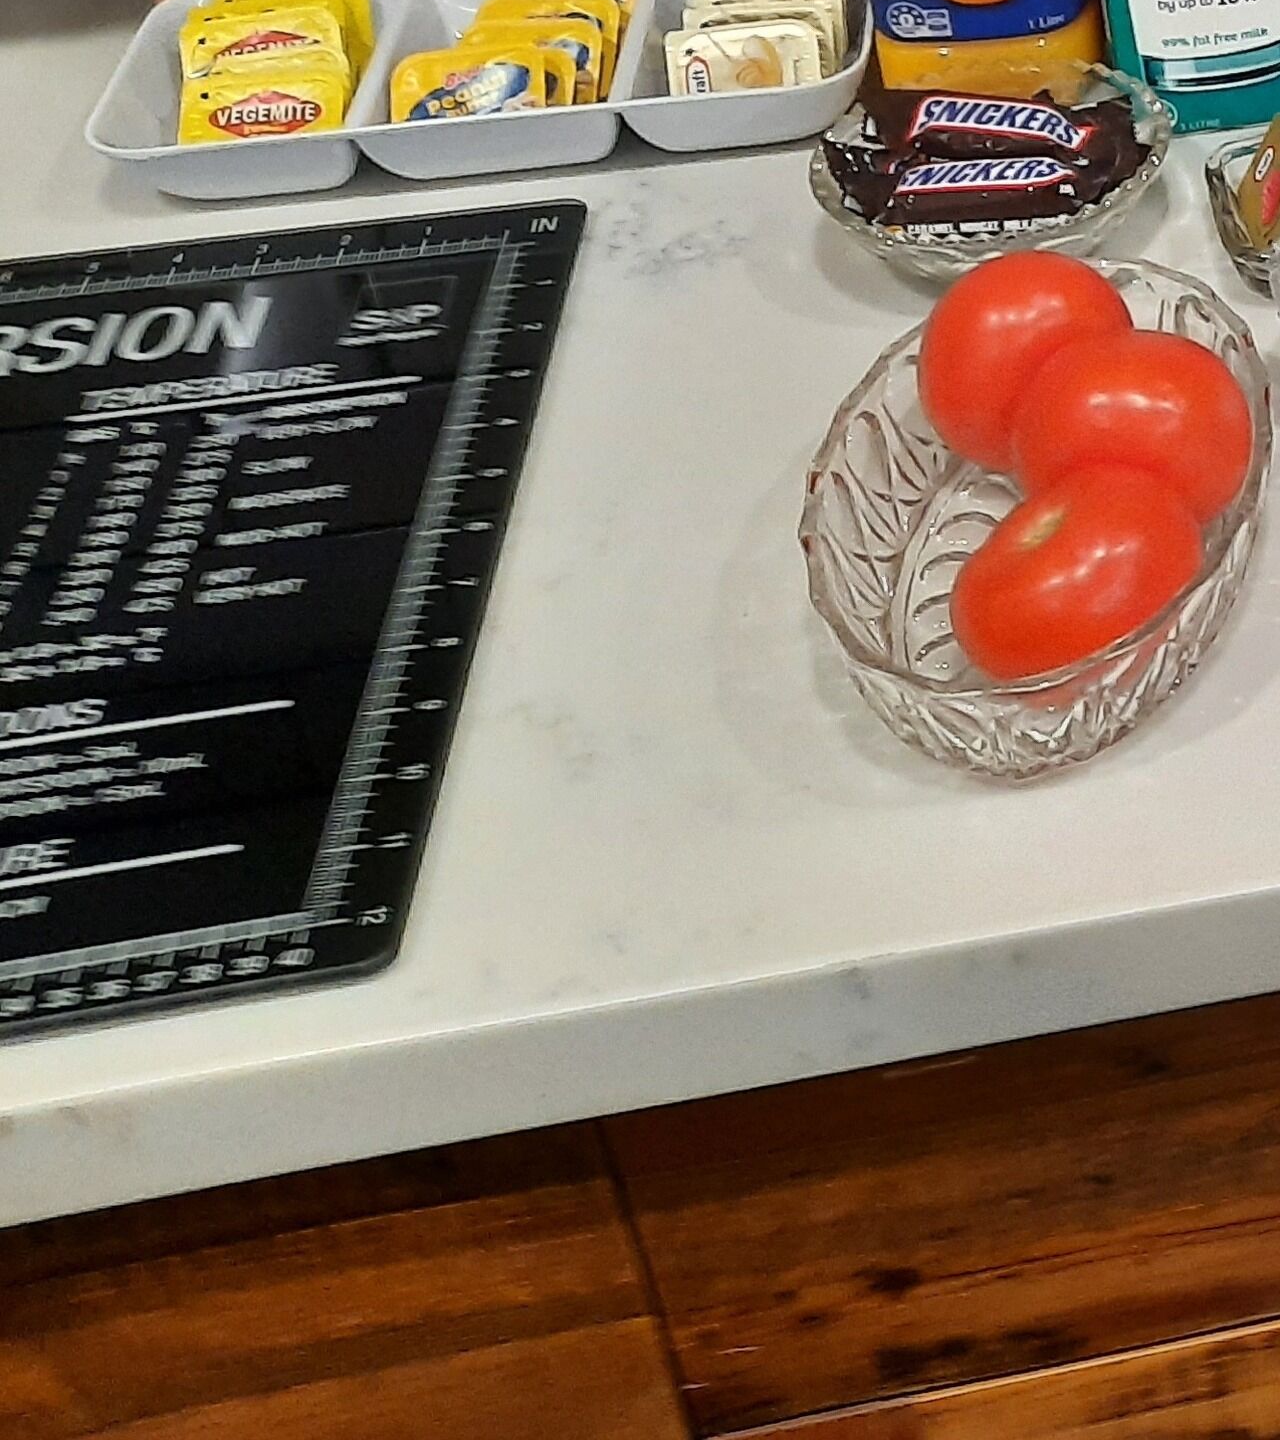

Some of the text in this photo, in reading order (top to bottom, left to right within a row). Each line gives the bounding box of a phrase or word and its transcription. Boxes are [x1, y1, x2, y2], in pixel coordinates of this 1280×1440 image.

[1157, 0, 1175, 13] by
[216, 102, 317, 127] VEGEMITE
[921, 100, 1080, 146] SNICKERS
[900, 159, 1062, 188] SNICKERS
[529, 215, 559, 234] IN
